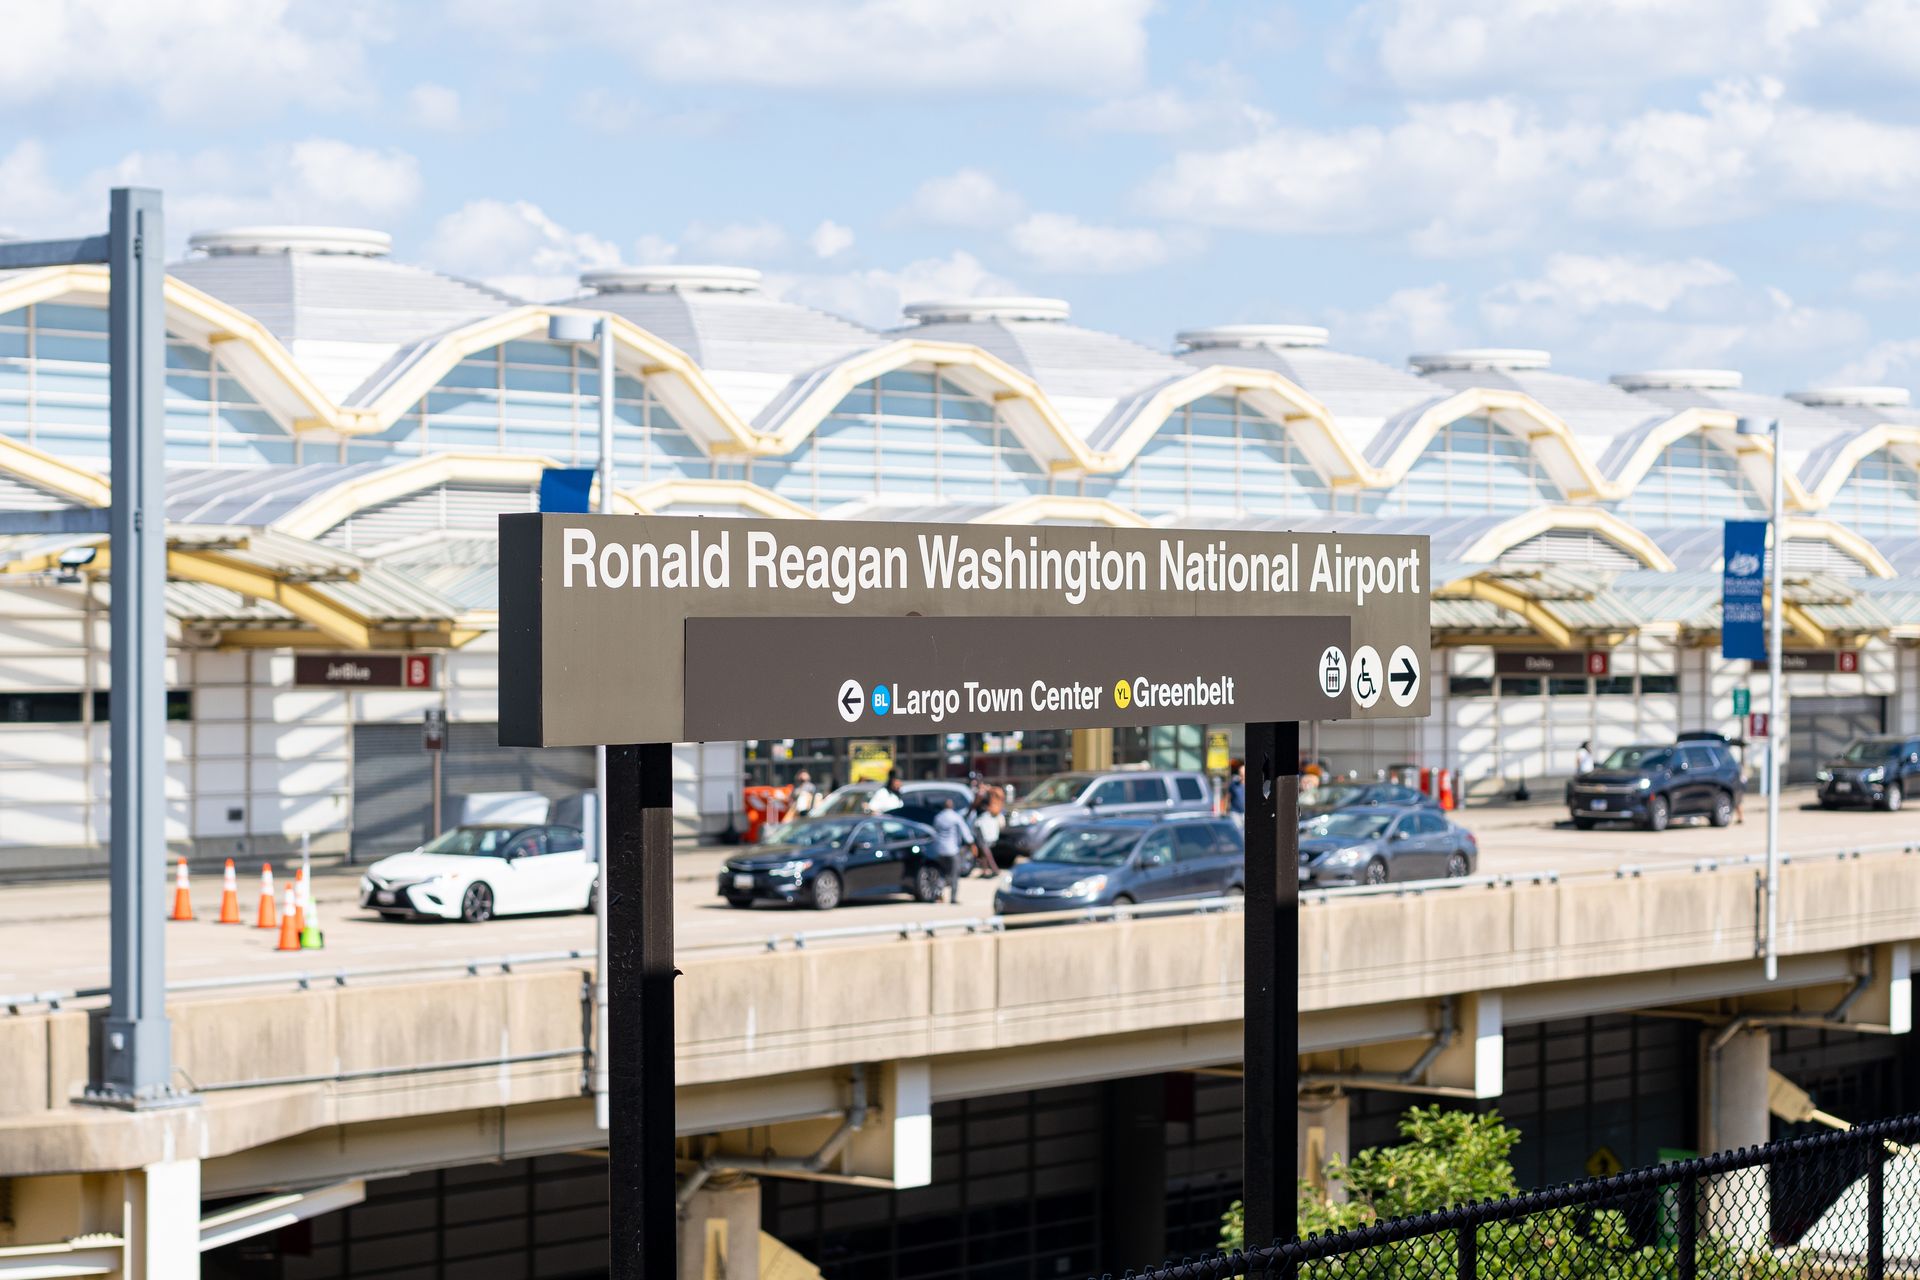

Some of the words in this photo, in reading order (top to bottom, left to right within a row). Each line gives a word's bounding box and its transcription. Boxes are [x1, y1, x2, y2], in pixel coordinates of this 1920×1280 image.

[563, 527, 730, 589] Ronald
[747, 531, 908, 605] Reagan
[917, 534, 1147, 605] Washington
[1159, 539, 1299, 593] National
[1309, 543, 1420, 606] Airport
[326, 663, 370, 680] JetBlue
[411, 660, 425, 684] B
[874, 693, 888, 707] BL
[892, 683, 960, 722] Largo
[963, 681, 1023, 713] Town
[1030, 679, 1103, 711] Center
[1117, 688, 1129, 700] YL
[1133, 675, 1235, 708] Greenbelt
